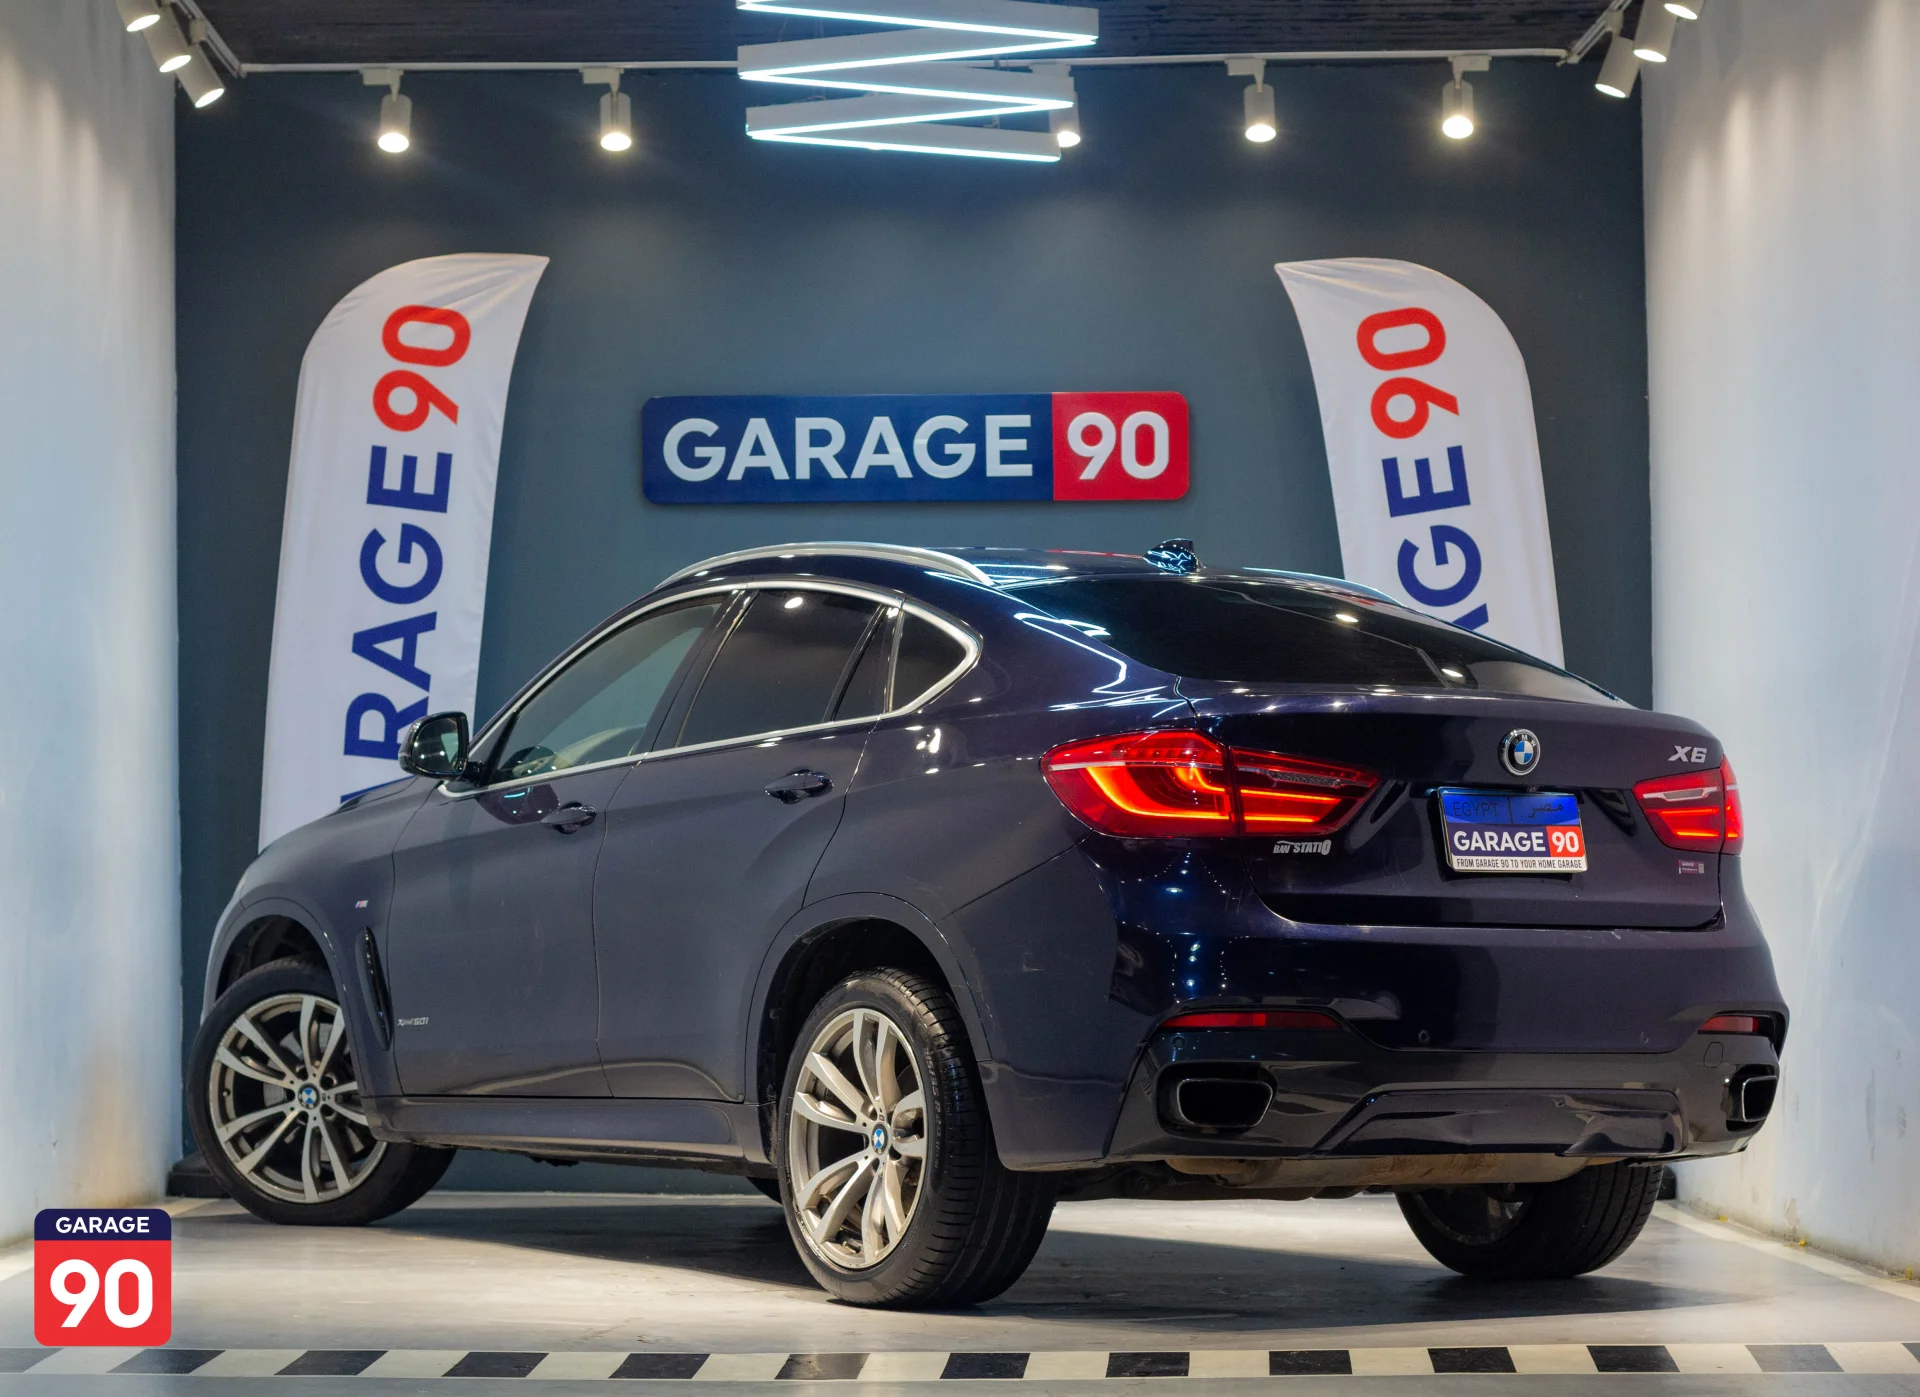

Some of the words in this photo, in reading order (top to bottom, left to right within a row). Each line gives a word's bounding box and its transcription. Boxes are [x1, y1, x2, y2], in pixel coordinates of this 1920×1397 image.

[372, 304, 471, 432] 90
[1356, 307, 1460, 439] 90
[662, 414, 1033, 483] GARAGE
[1066, 410, 1170, 481] 90
[340, 445, 453, 803] RAGE
[1667, 745, 1708, 763] X6
[1453, 801, 1498, 817] EGYPT
[1453, 830, 1546, 852] GARAGE
[1551, 831, 1580, 853] 90
[1456, 858, 1474, 868] FROM
[1475, 858, 1499, 868] GARAGE
[1500, 859, 1509, 868] 90
[1510, 859, 1519, 868] TO
[1520, 859, 1537, 868] YOUR
[1538, 859, 1556, 868] HOME
[1557, 859, 1582, 869] GARAGE
